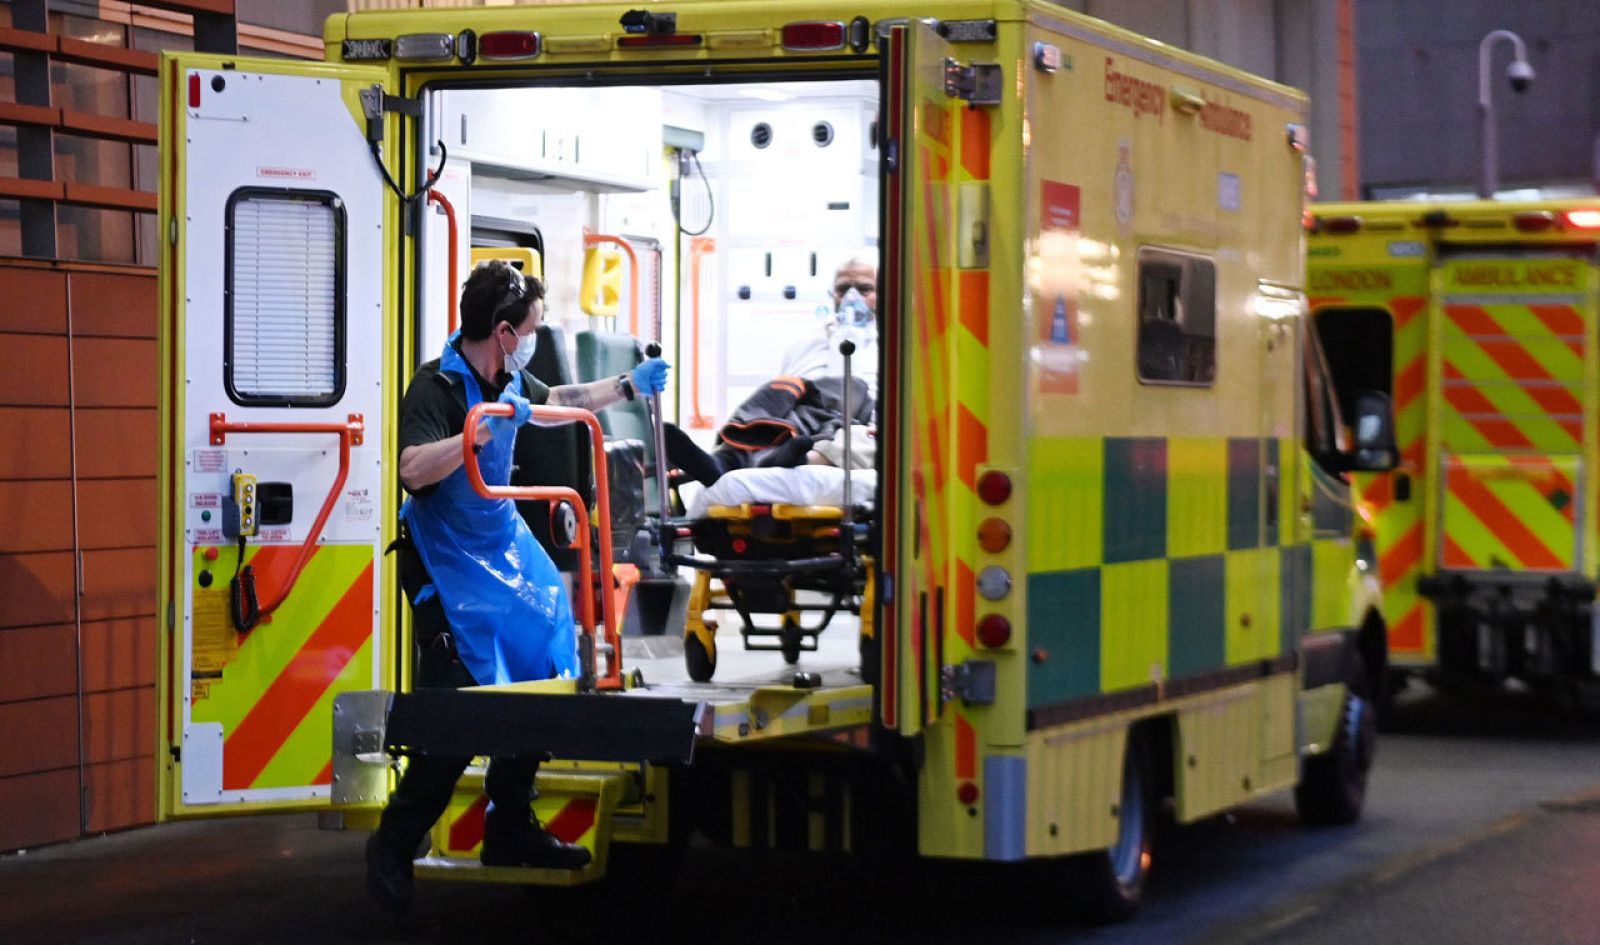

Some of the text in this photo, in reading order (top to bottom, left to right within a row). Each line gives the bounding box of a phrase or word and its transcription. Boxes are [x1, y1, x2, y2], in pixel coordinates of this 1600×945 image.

[1104, 57, 1166, 126] Emergency
[1311, 268, 1393, 291] LONDON
[1454, 264, 1578, 287] AMBULANCE
